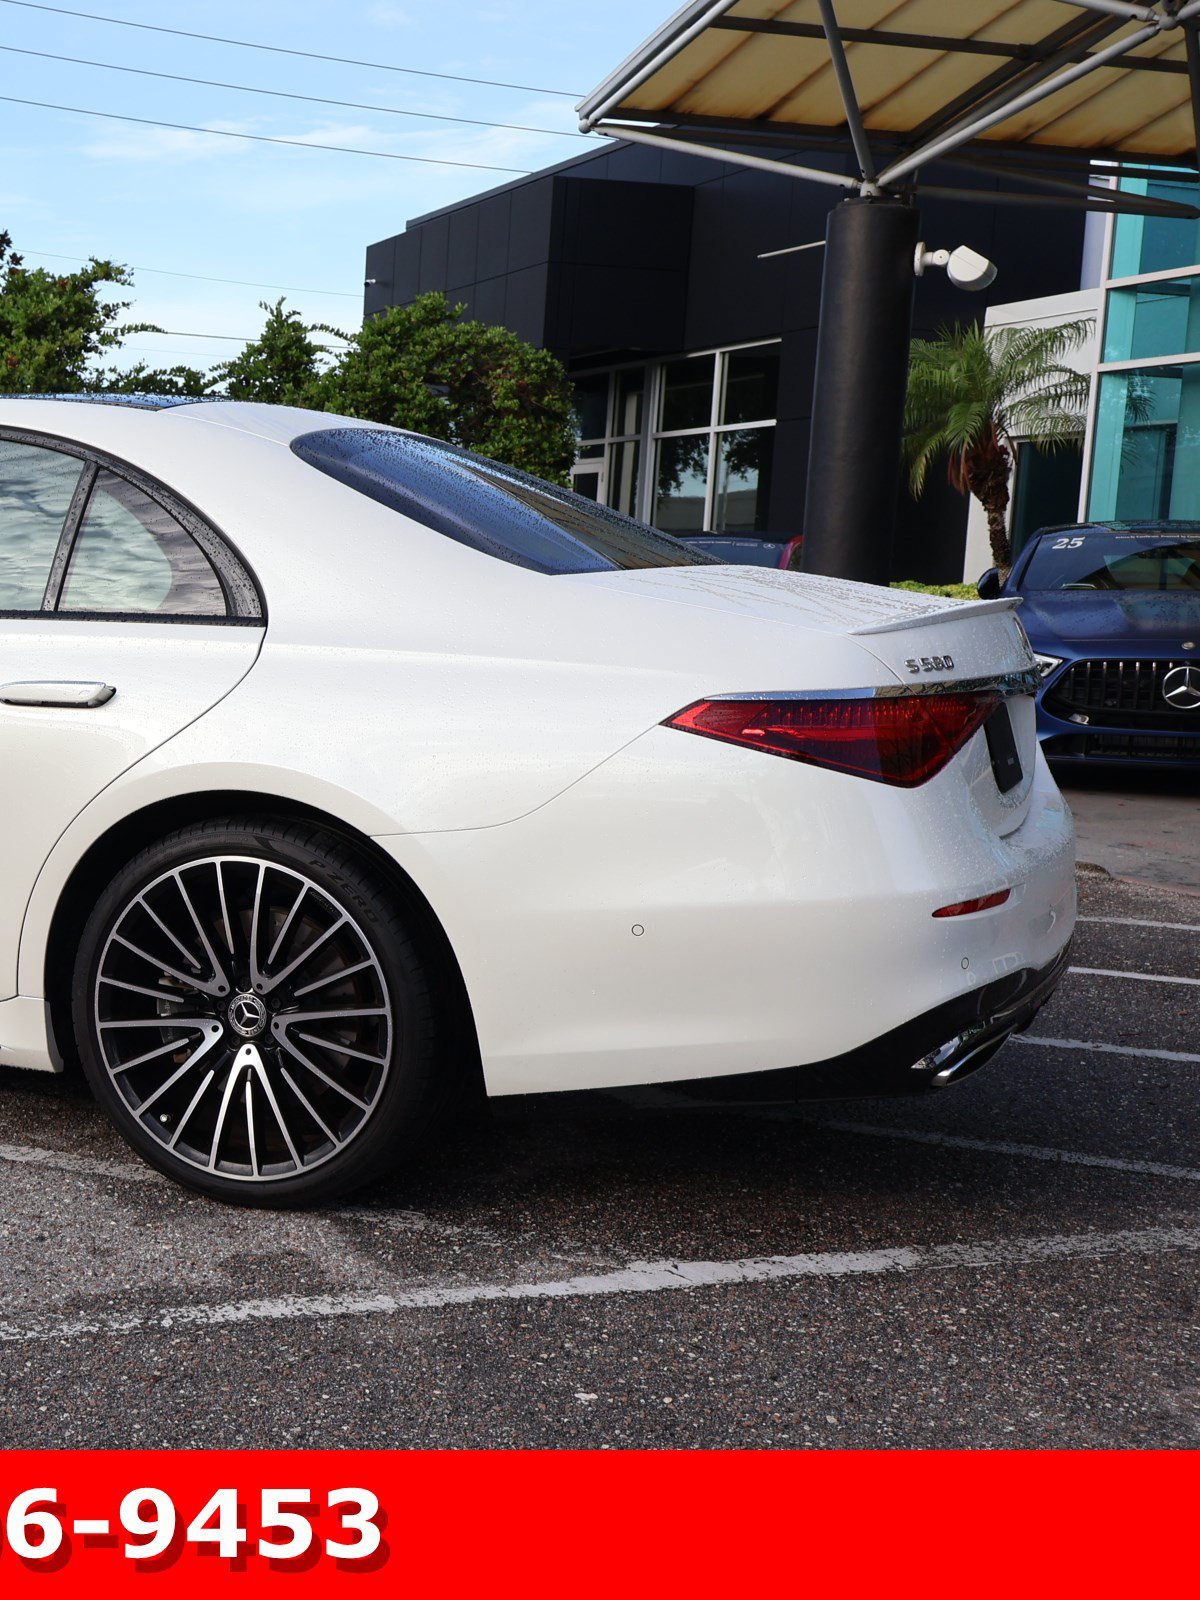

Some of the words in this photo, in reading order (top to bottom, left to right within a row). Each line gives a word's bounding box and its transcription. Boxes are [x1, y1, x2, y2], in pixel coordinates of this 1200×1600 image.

[1052, 537, 1086, 550] 25
[904, 659, 920, 674] S
[919, 655, 955, 672] 580
[308, 859, 326, 868] P
[327, 872, 378, 923] ZERO
